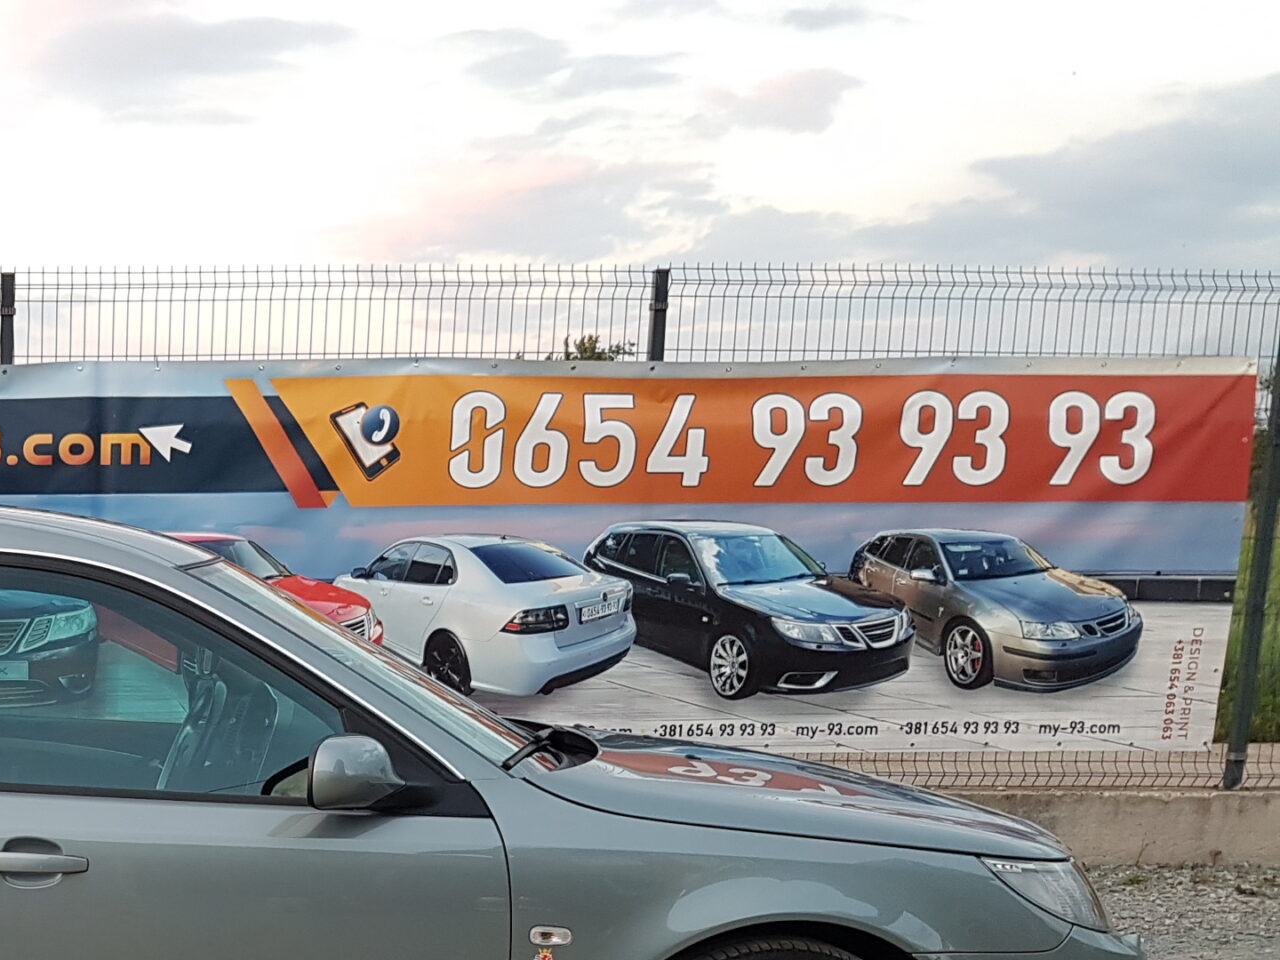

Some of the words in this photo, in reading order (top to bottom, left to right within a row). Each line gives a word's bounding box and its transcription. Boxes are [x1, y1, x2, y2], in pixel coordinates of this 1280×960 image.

[448, 390, 710, 488] 0654
[750, 392, 863, 488] 93
[898, 390, 1010, 487] 93
[1047, 390, 1157, 487] 93
[1185, 627, 1204, 682] DESIGN
[1183, 685, 1195, 694] &
[1164, 693, 1177, 715] 063
[963, 721, 979, 734] 93
[983, 721, 999, 734] 93
[1003, 721, 1020, 734] 93
[1177, 697, 1193, 741] PRINT
[719, 723, 735, 736] 93
[739, 723, 755, 736] 93
[760, 722, 776, 736] 93
[796, 722, 878, 739] my-93.com
[1039, 721, 1120, 737] my-93.com
[1161, 718, 1173, 741] 063
